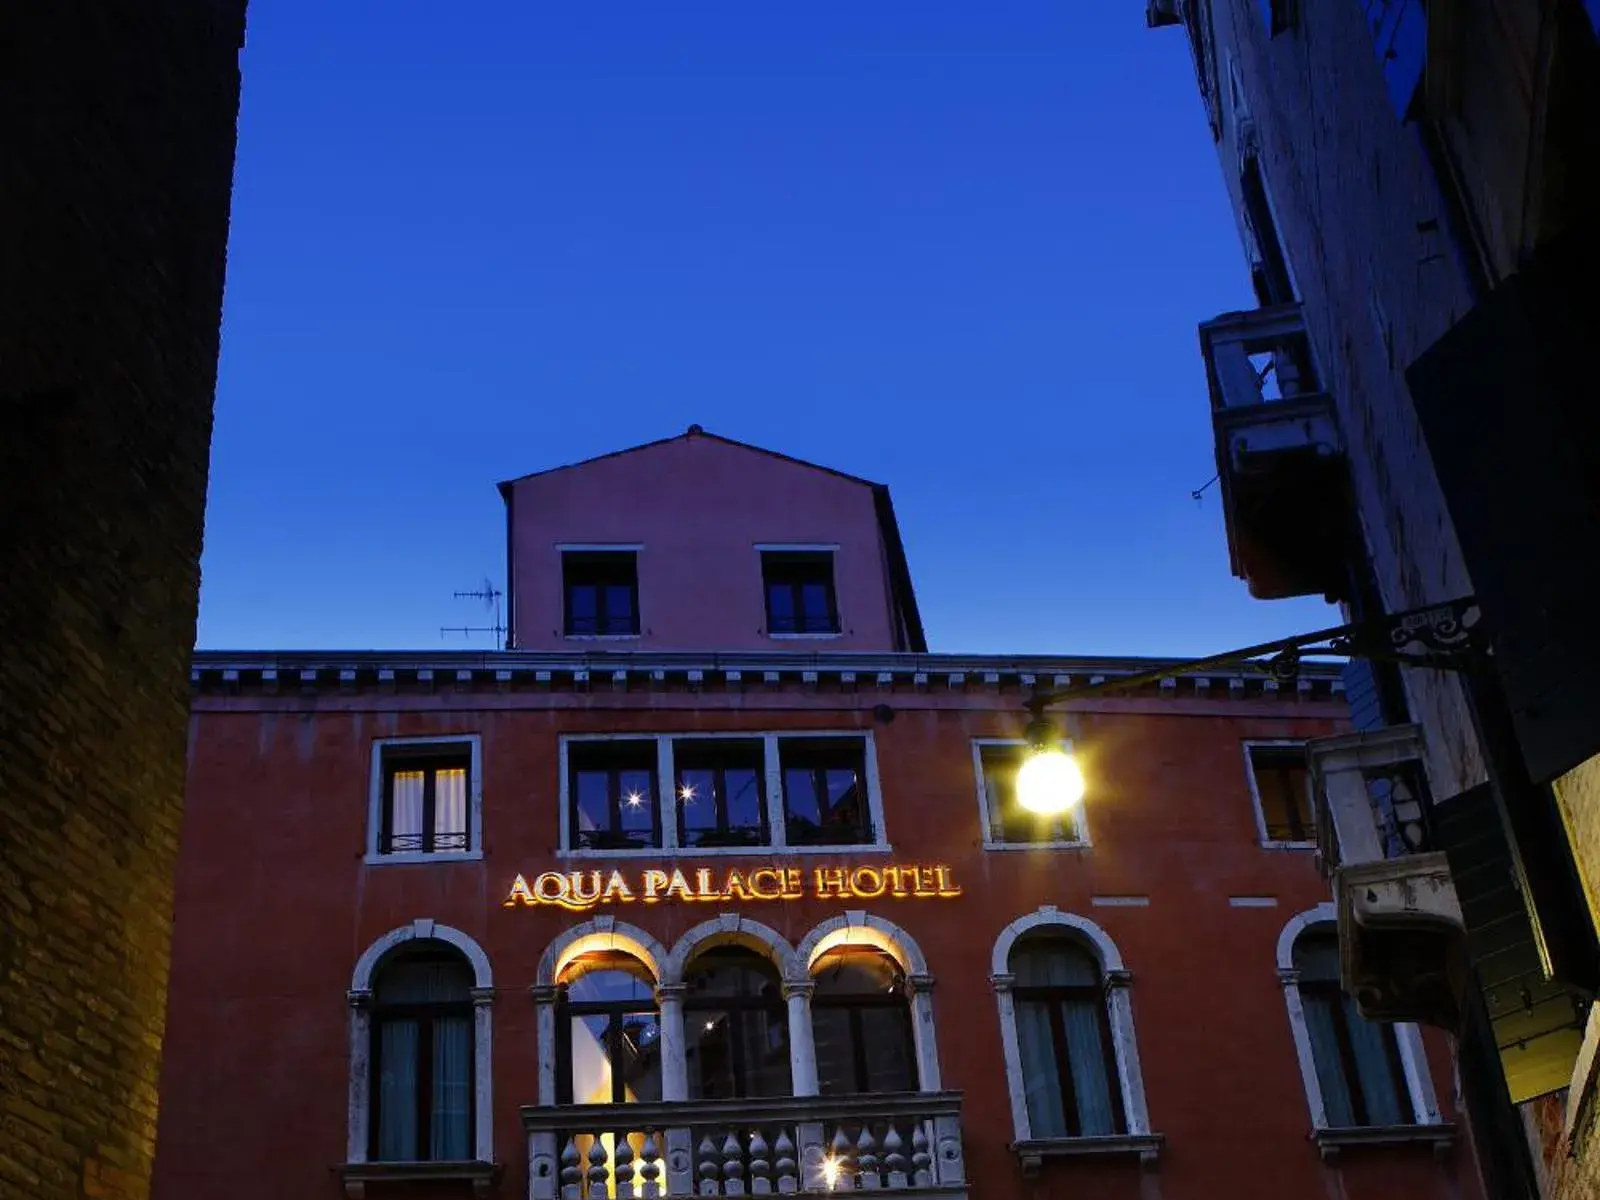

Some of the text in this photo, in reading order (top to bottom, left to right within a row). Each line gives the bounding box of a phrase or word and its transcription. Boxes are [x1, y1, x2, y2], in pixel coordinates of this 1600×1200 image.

[504, 864, 961, 911] AQUA PALACE HOTEL
